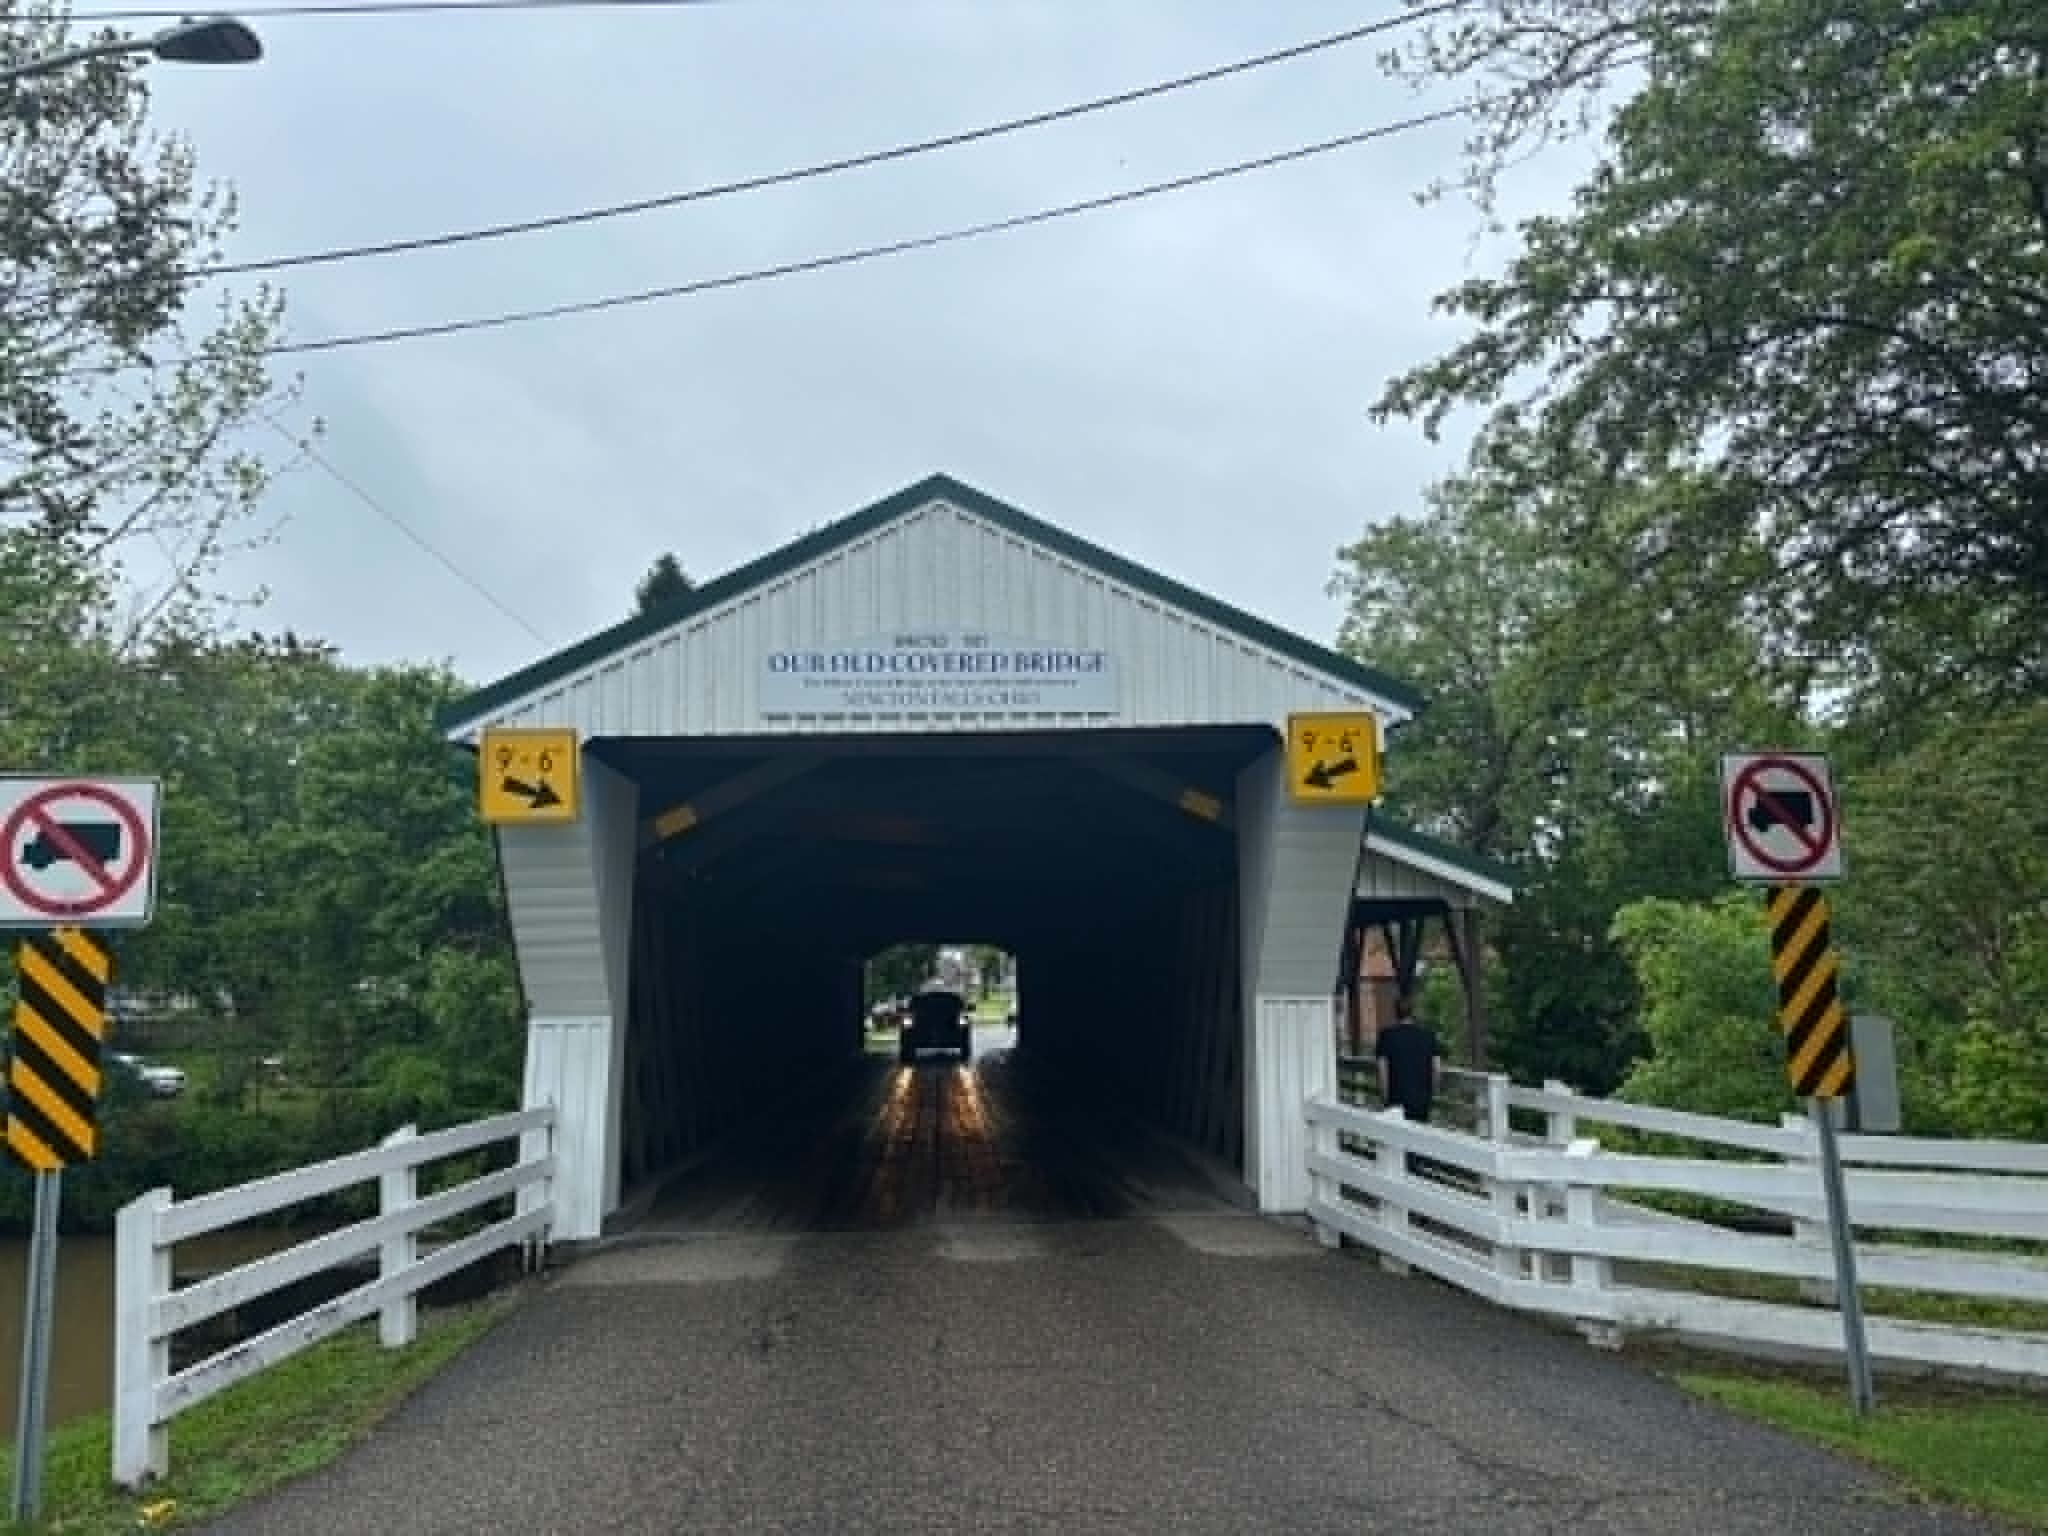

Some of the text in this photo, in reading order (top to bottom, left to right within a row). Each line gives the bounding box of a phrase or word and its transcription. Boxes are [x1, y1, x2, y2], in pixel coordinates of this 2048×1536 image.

[767, 652, 1107, 672] OUR OLD COVERED BRIDGE
